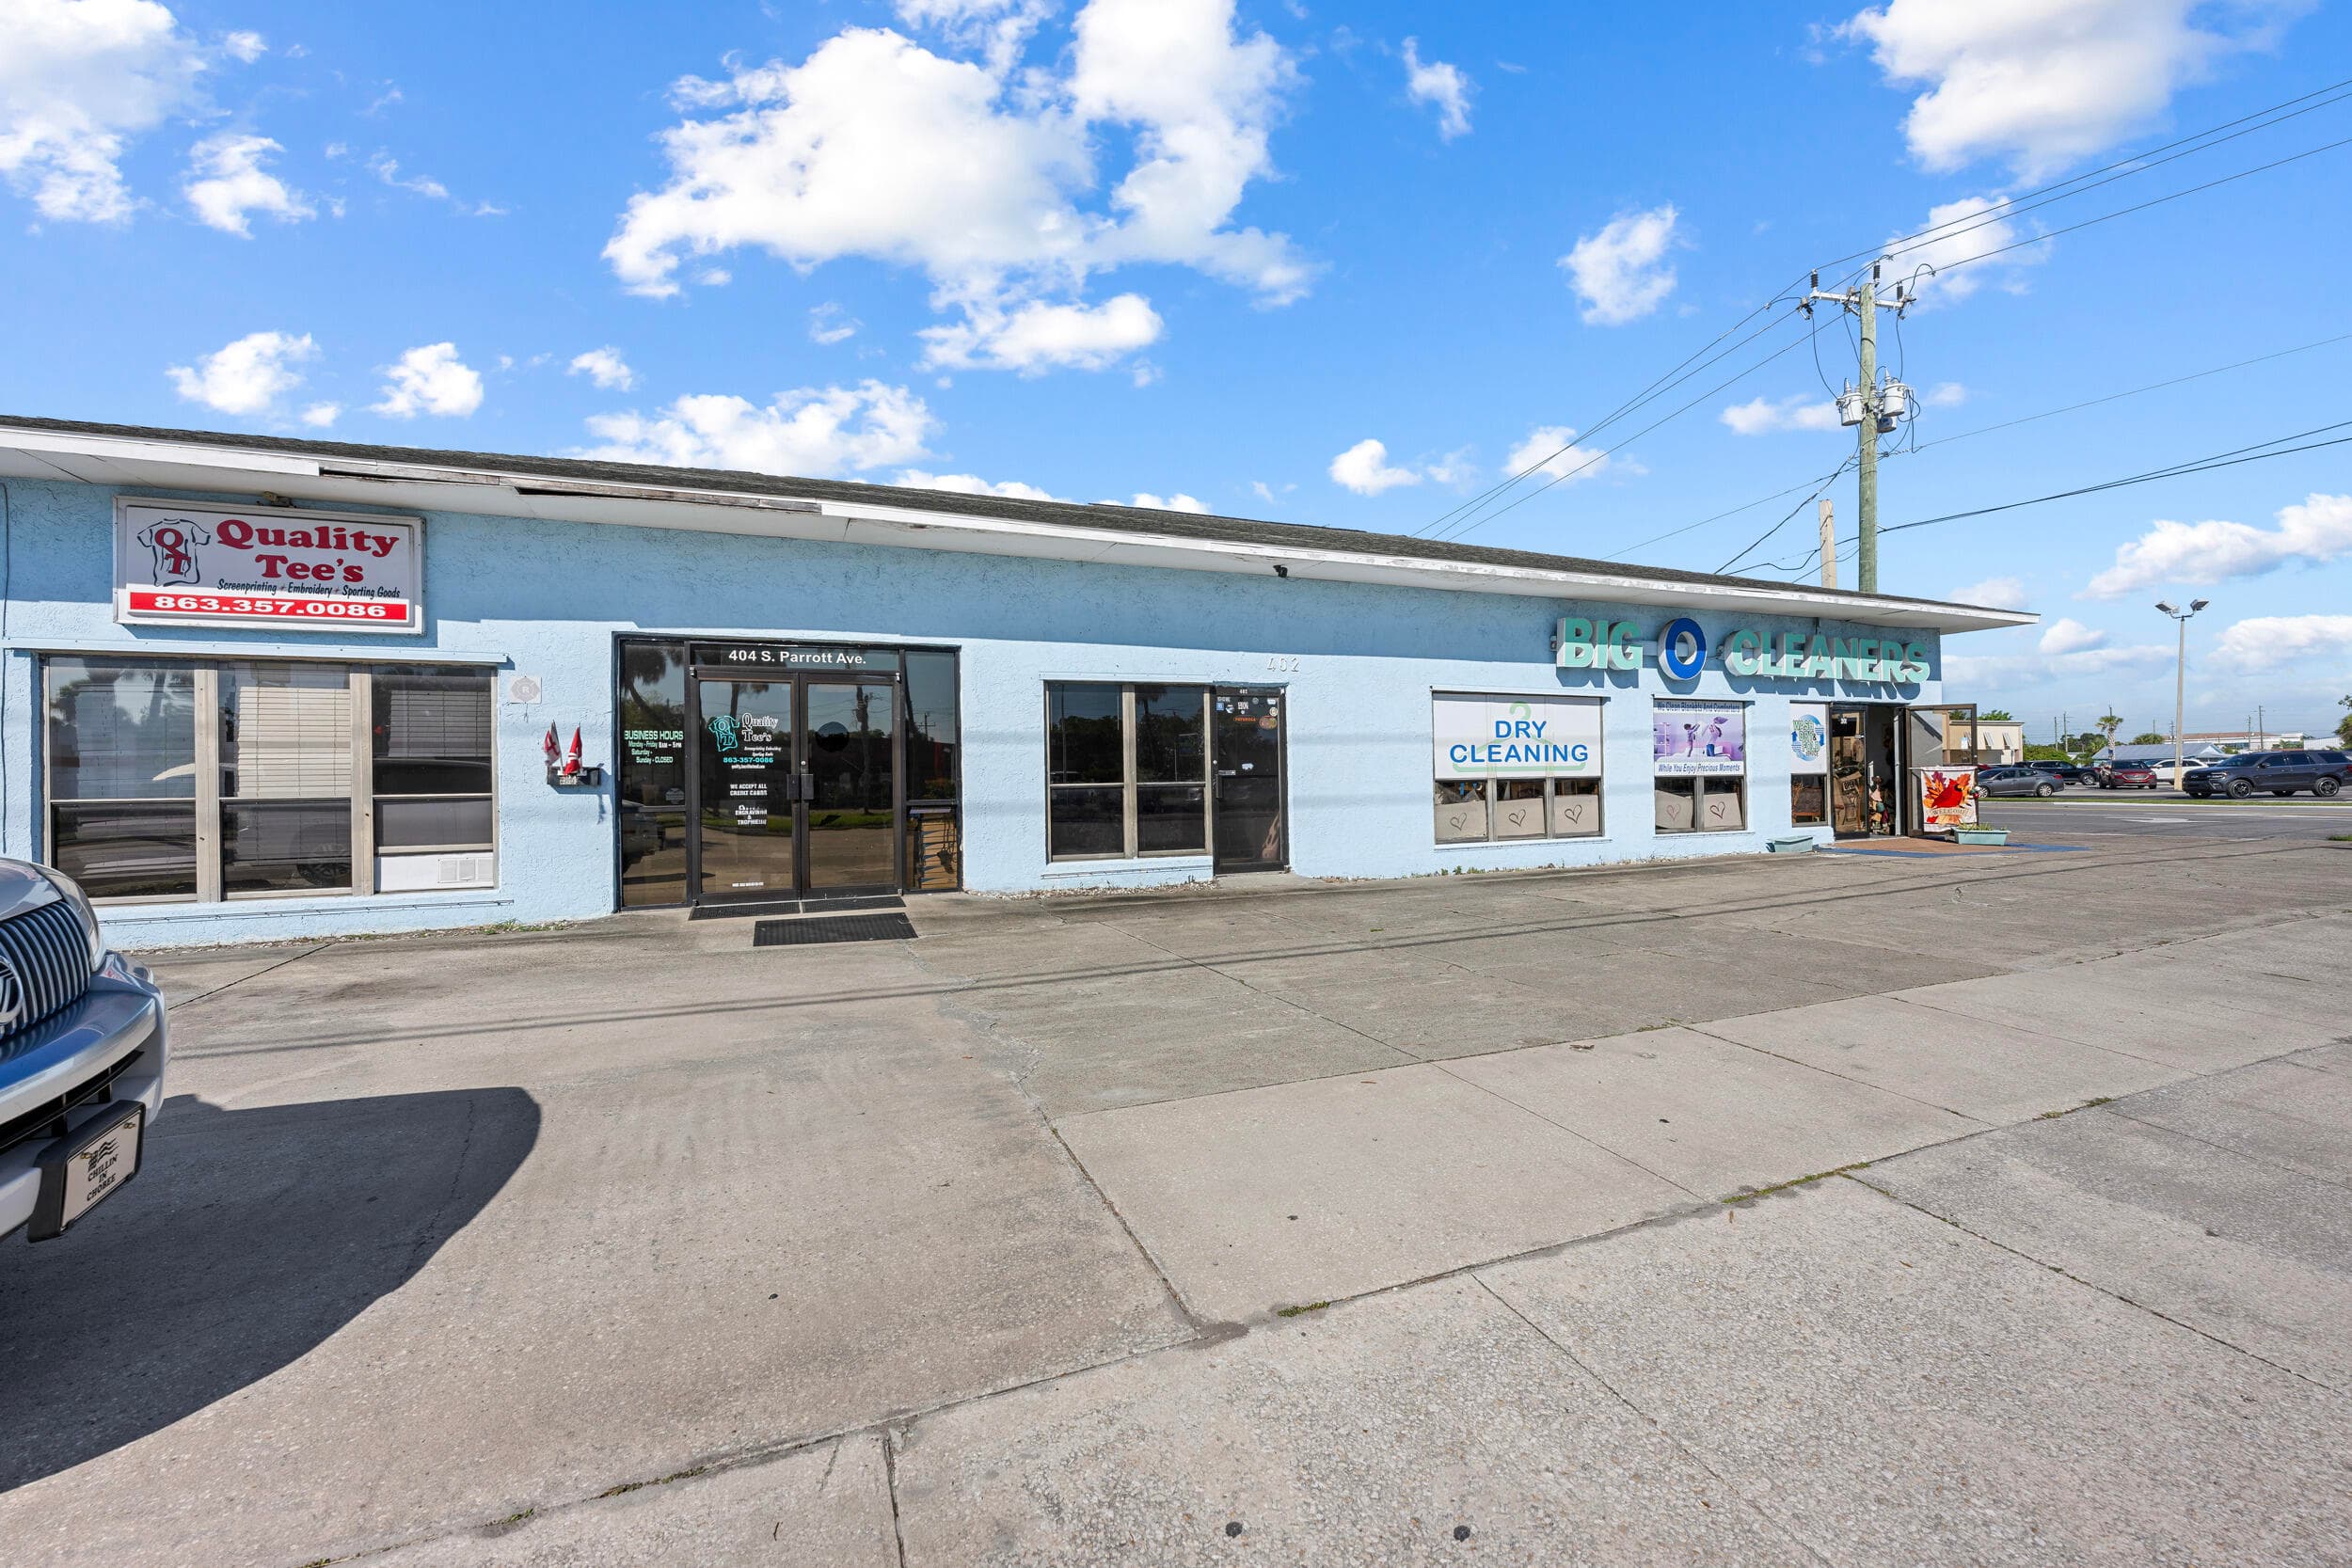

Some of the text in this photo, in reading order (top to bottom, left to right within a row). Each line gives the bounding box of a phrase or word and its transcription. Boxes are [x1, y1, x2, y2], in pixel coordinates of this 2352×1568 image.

[154, 528, 186, 555] Q
[216, 519, 399, 558] Quality
[255, 554, 364, 582] Tee's
[217, 578, 400, 599] Screenprinting Embroidery Sporting Goods
[154, 596, 386, 617] 863.357.0086
[1557, 617, 1643, 670] BIG
[1658, 617, 1708, 681] O
[729, 650, 866, 664] 404 S. Parrott Ave.
[1267, 657, 1299, 673] 402
[1724, 628, 1931, 684] CLEANERS
[742, 712, 778, 730] Quality
[1495, 721, 1547, 738] DRY
[1793, 720, 1814, 731] WASH
[624, 730, 684, 740] BUSINESS HOURS
[636, 756, 651, 765] Sunday
[1450, 744, 1588, 763] CLEANING
[1659, 764, 1673, 772] While
[1683, 764, 1696, 774] Enjoy
[1697, 763, 1719, 772] Precious
[1719, 763, 1740, 772] Moments
[99, 1170, 108, 1182] IN
[87, 1173, 116, 1201] CHOBEE
